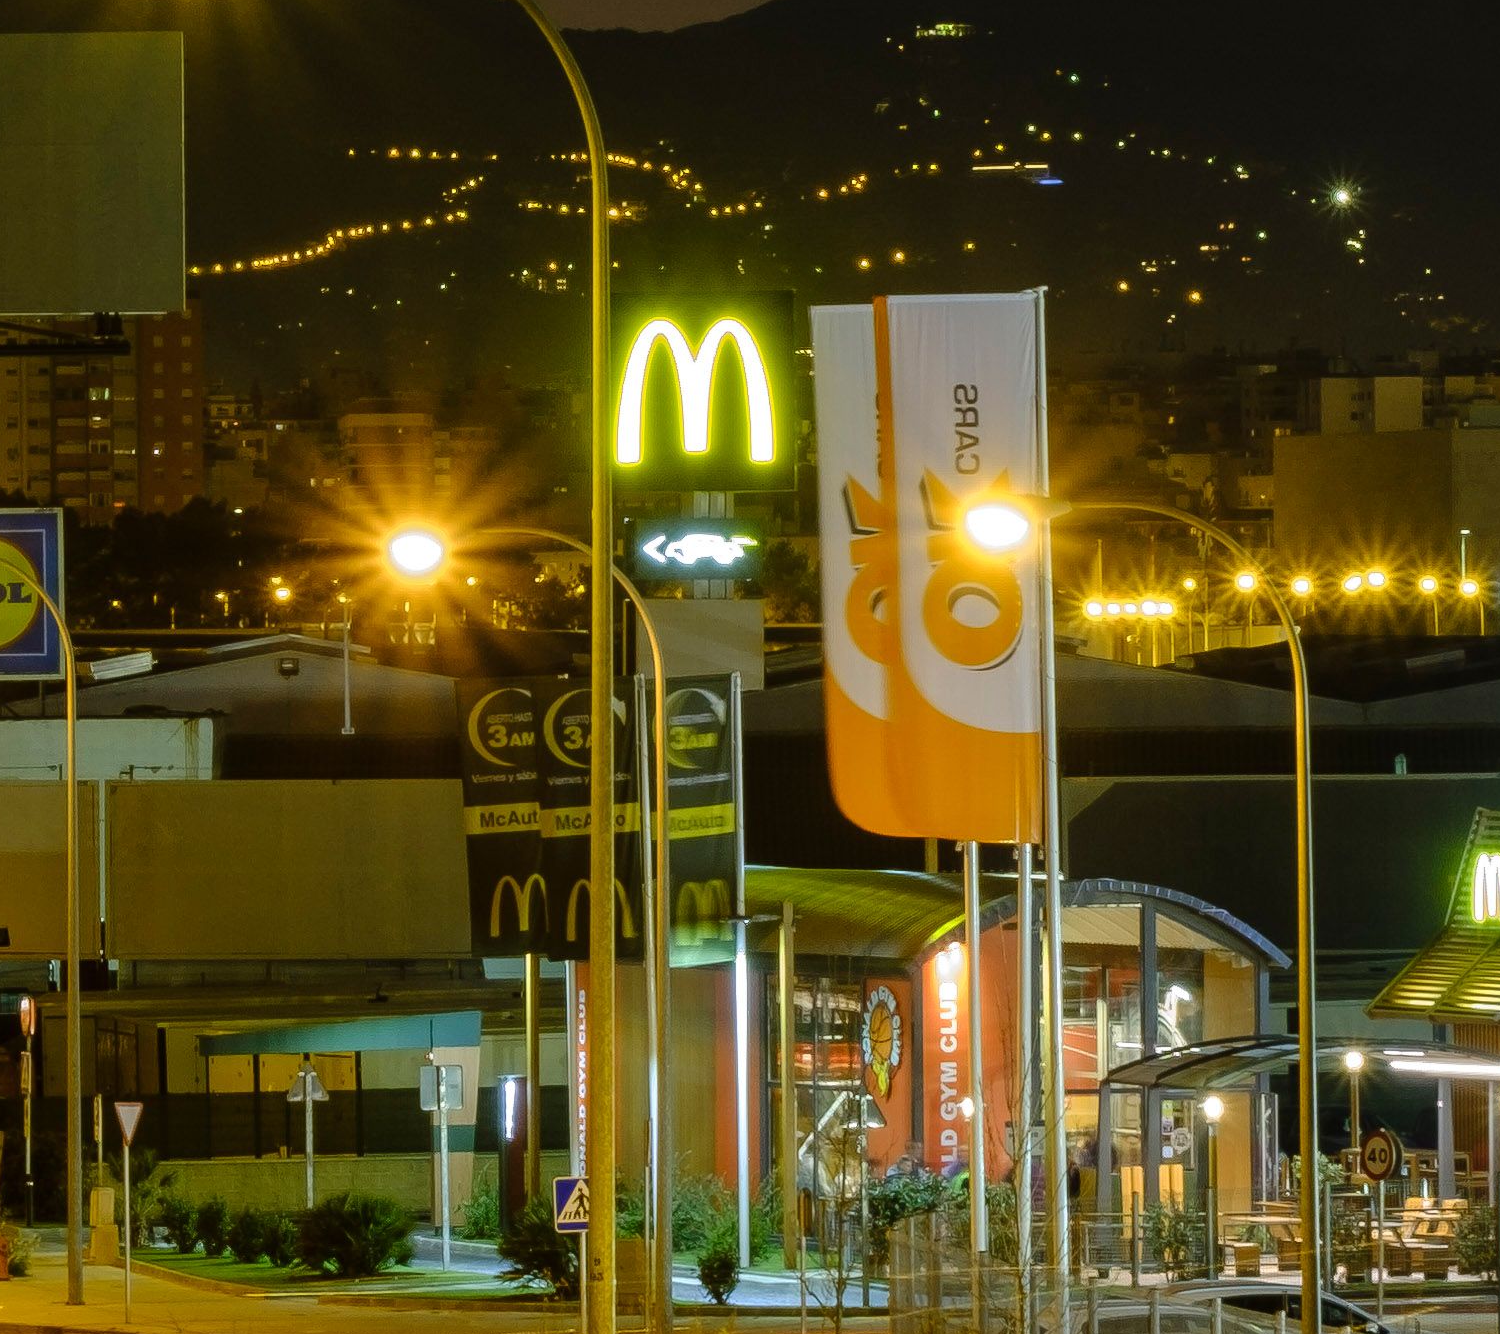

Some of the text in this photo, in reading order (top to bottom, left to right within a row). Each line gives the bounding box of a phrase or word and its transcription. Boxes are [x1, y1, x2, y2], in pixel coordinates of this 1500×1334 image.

[479, 810, 538, 828] McAut
[555, 813, 626, 831] McAo
[577, 989, 587, 1045] CLUB
[939, 981, 959, 1054] CLUB
[577, 1051, 587, 1099] GYM
[939, 1061, 959, 1121] GYM
[1368, 1147, 1387, 1164] 40
